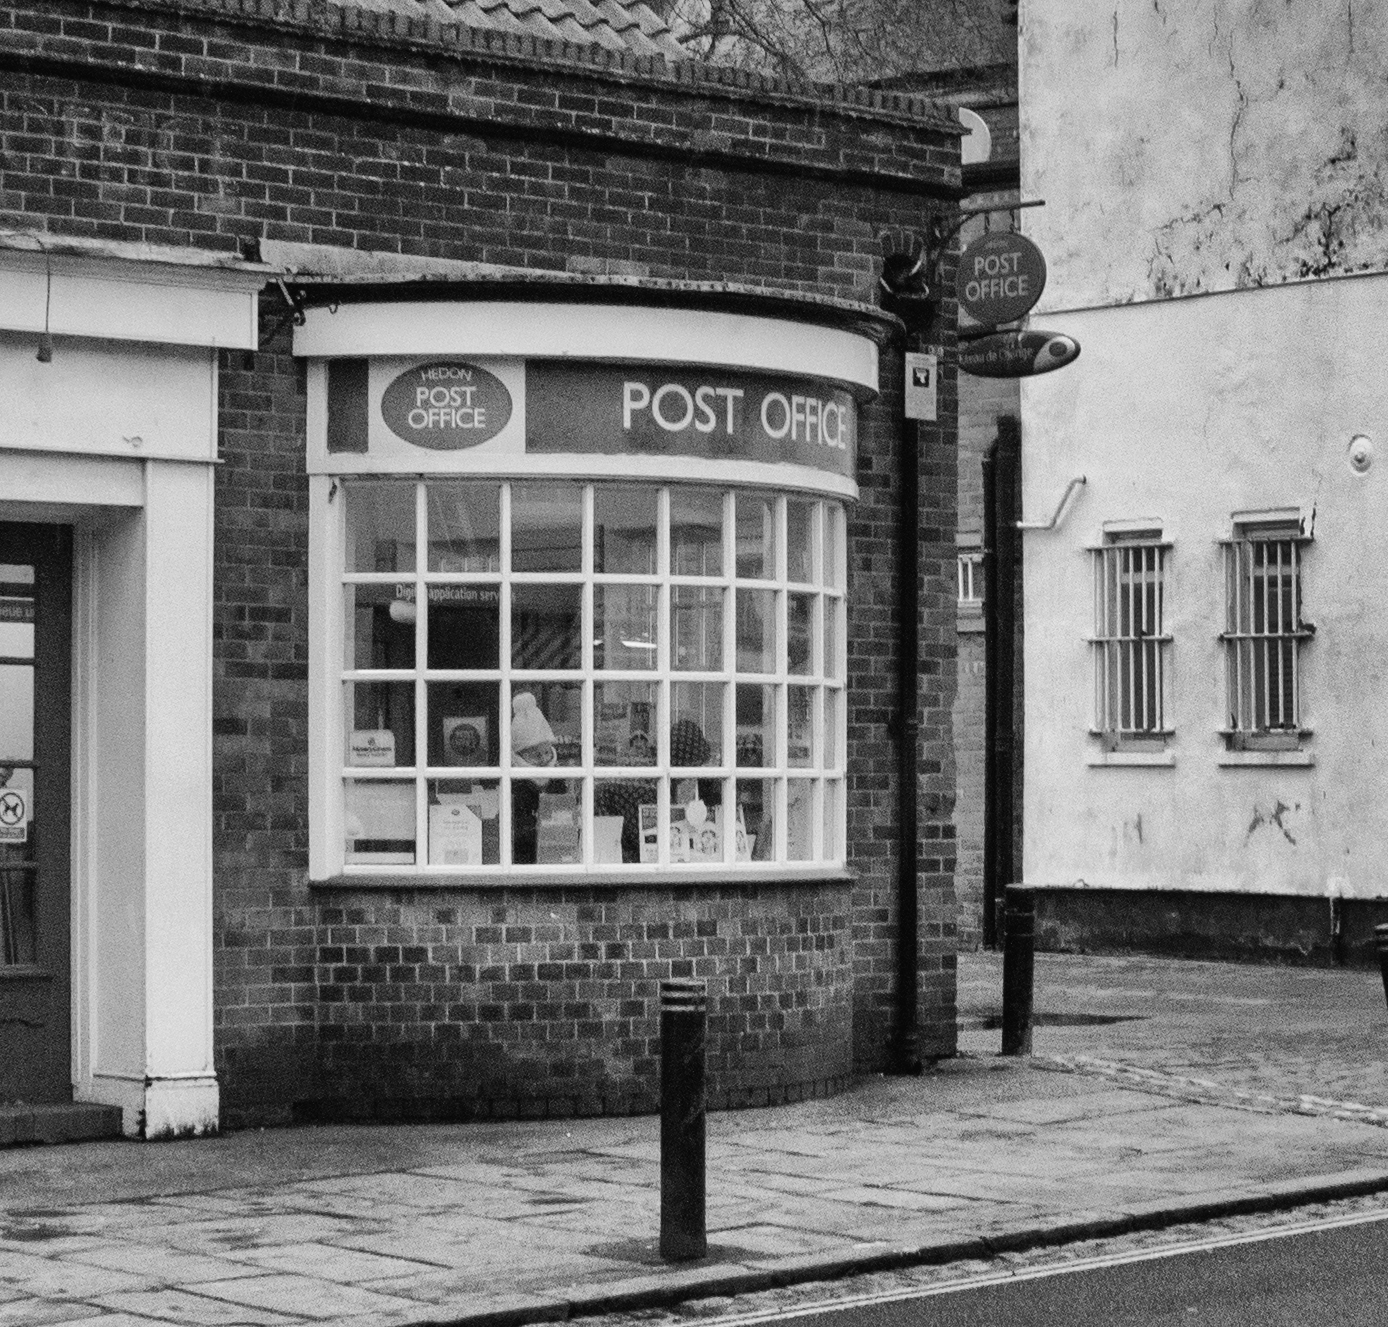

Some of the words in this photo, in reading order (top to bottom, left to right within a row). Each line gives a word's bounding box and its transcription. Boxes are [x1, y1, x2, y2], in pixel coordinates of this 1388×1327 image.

[974, 252, 1022, 277] POST
[965, 274, 1029, 302] OFFICE
[420, 366, 473, 381] HEDON
[416, 386, 477, 407] POST
[408, 408, 487, 430] OFFICE
[623, 382, 744, 435] POST
[760, 392, 847, 450] OFFICE
